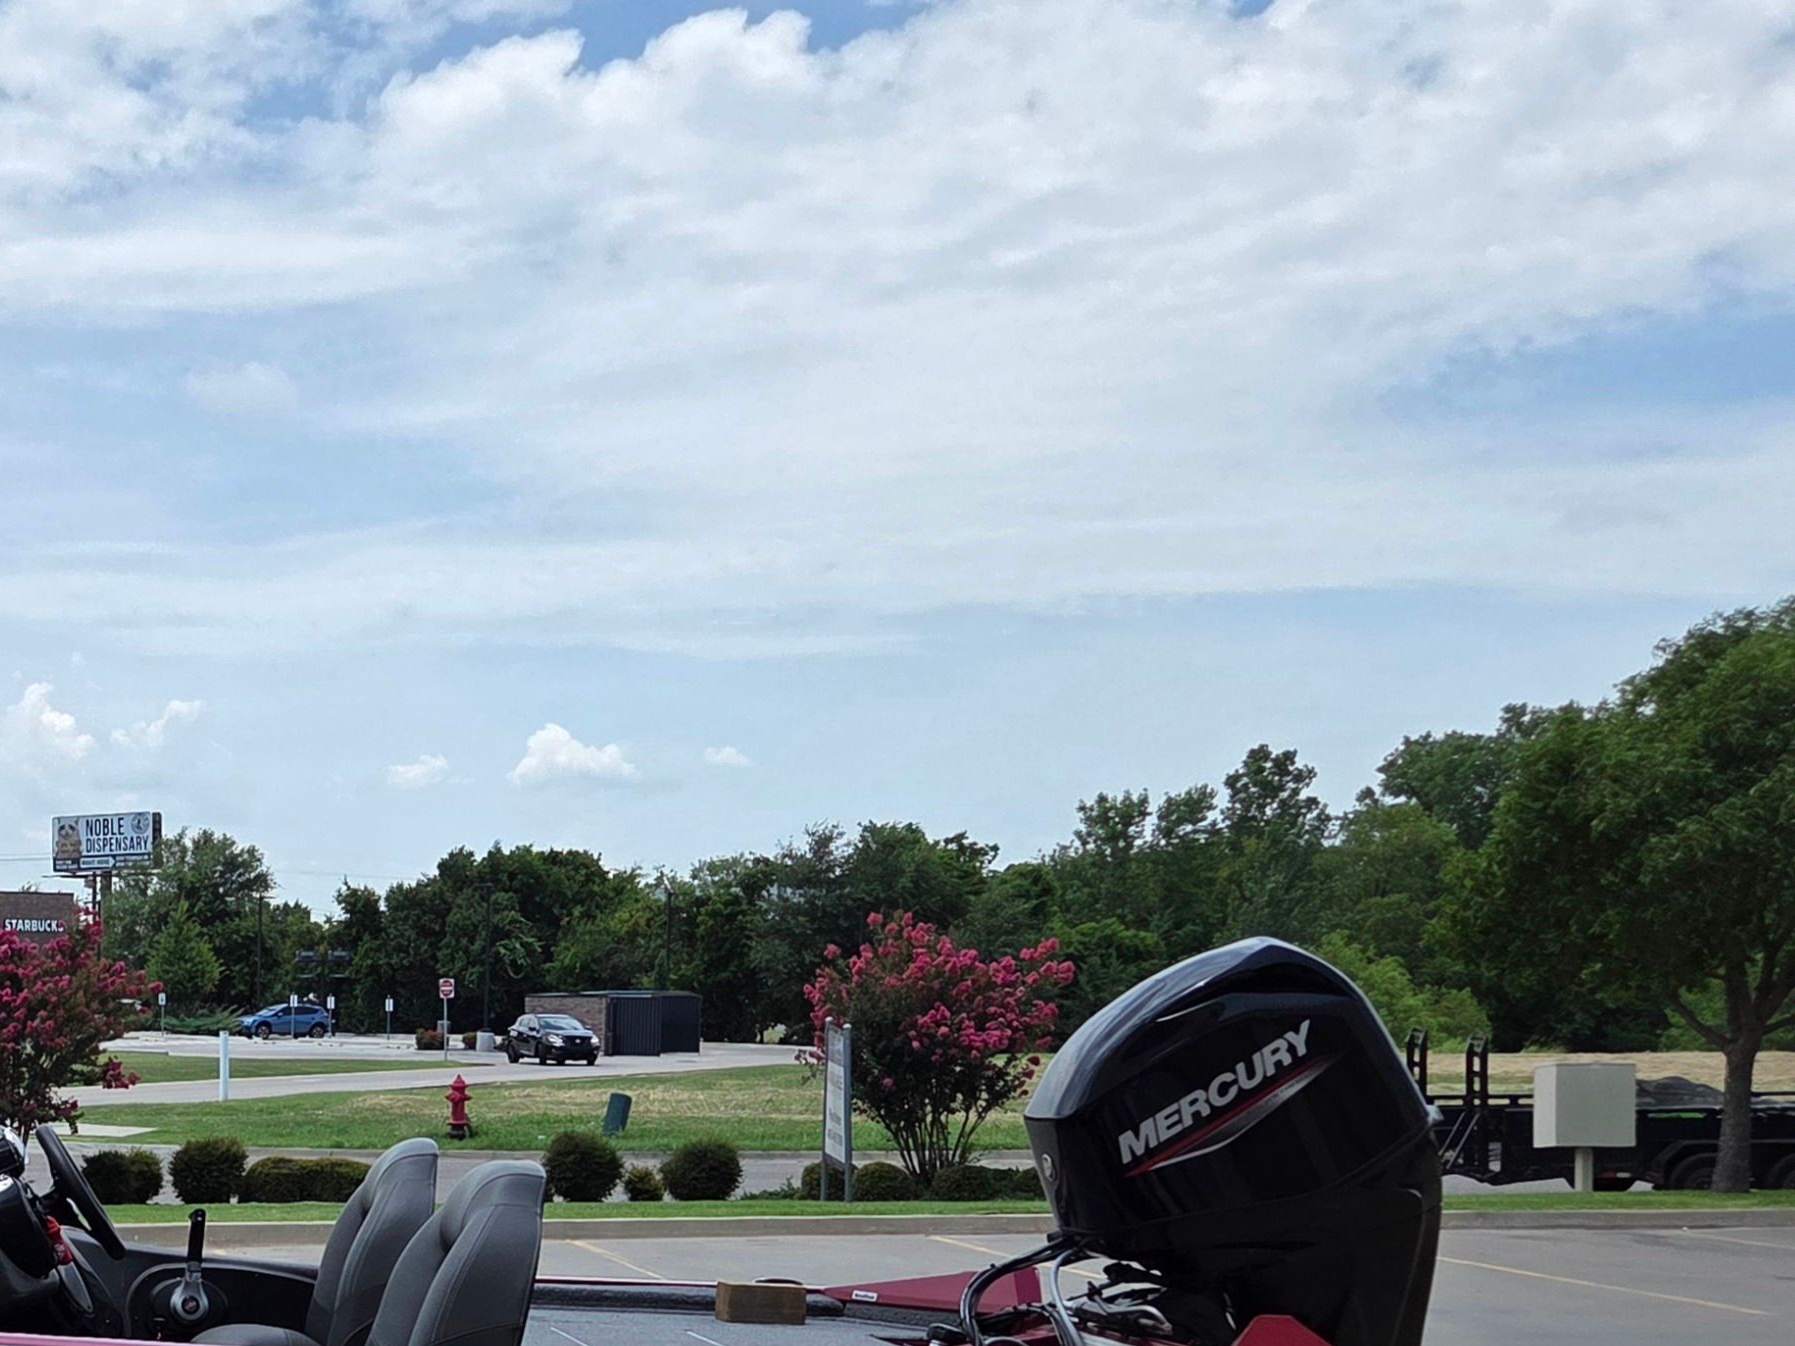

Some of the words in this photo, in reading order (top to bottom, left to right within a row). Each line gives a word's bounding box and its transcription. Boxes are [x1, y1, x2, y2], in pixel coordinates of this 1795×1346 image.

[86, 817, 124, 836] NOBLE
[85, 835, 149, 853] DISPENSARY
[1118, 1019, 1310, 1164] MERCURY
